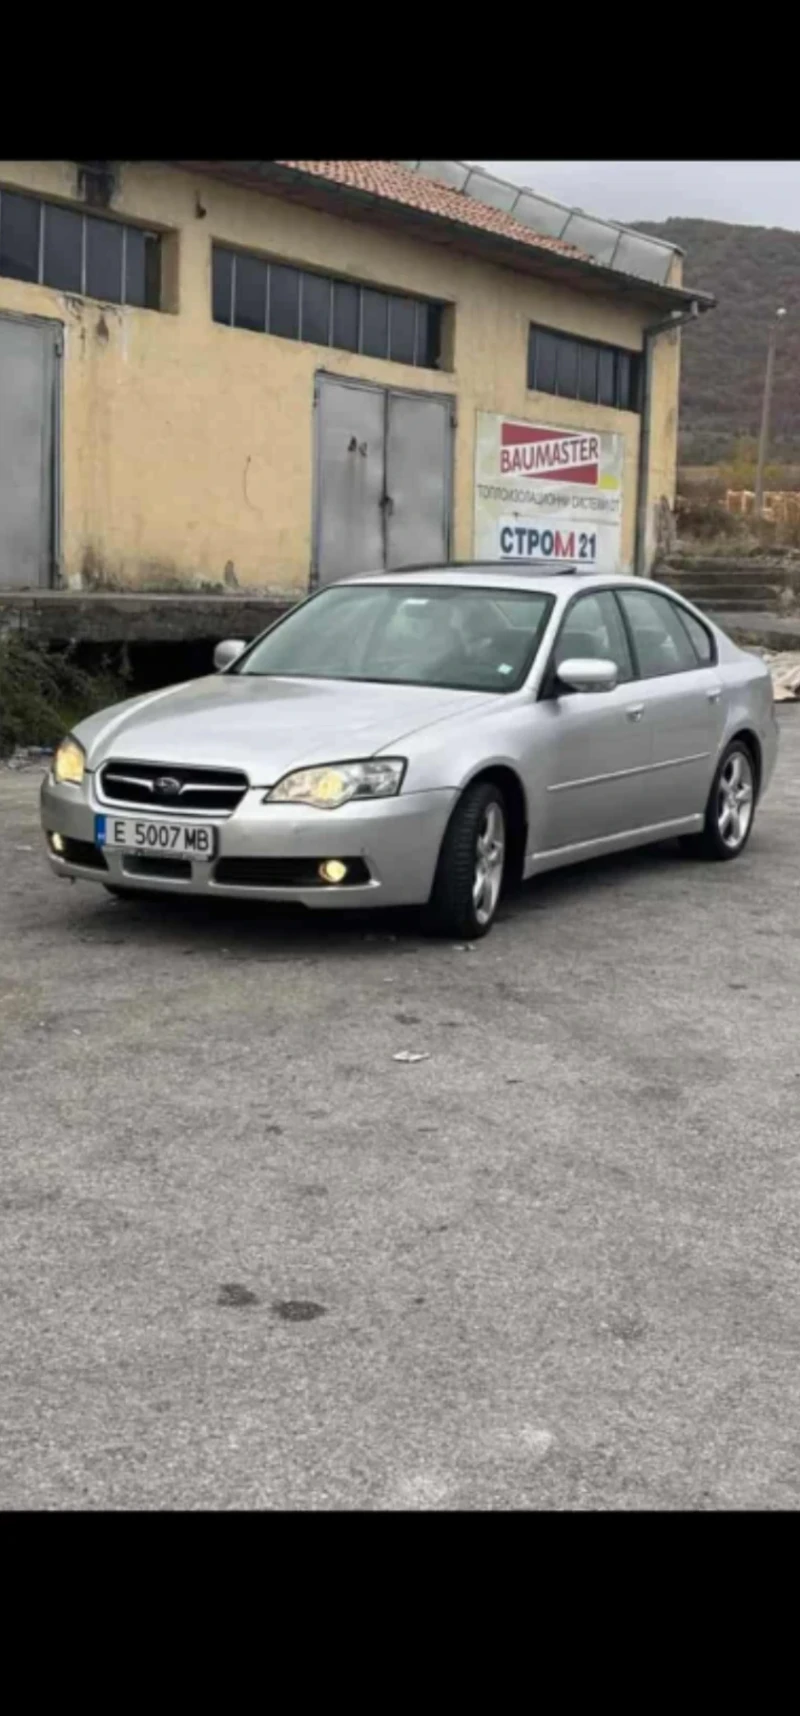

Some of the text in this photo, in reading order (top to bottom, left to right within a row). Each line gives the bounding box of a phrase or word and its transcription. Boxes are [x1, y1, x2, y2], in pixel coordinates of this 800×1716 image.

[501, 437, 598, 474] BAUMASTER
[501, 526, 596, 558] СТРОМ 21
[114, 821, 209, 851] E 5007 MB
